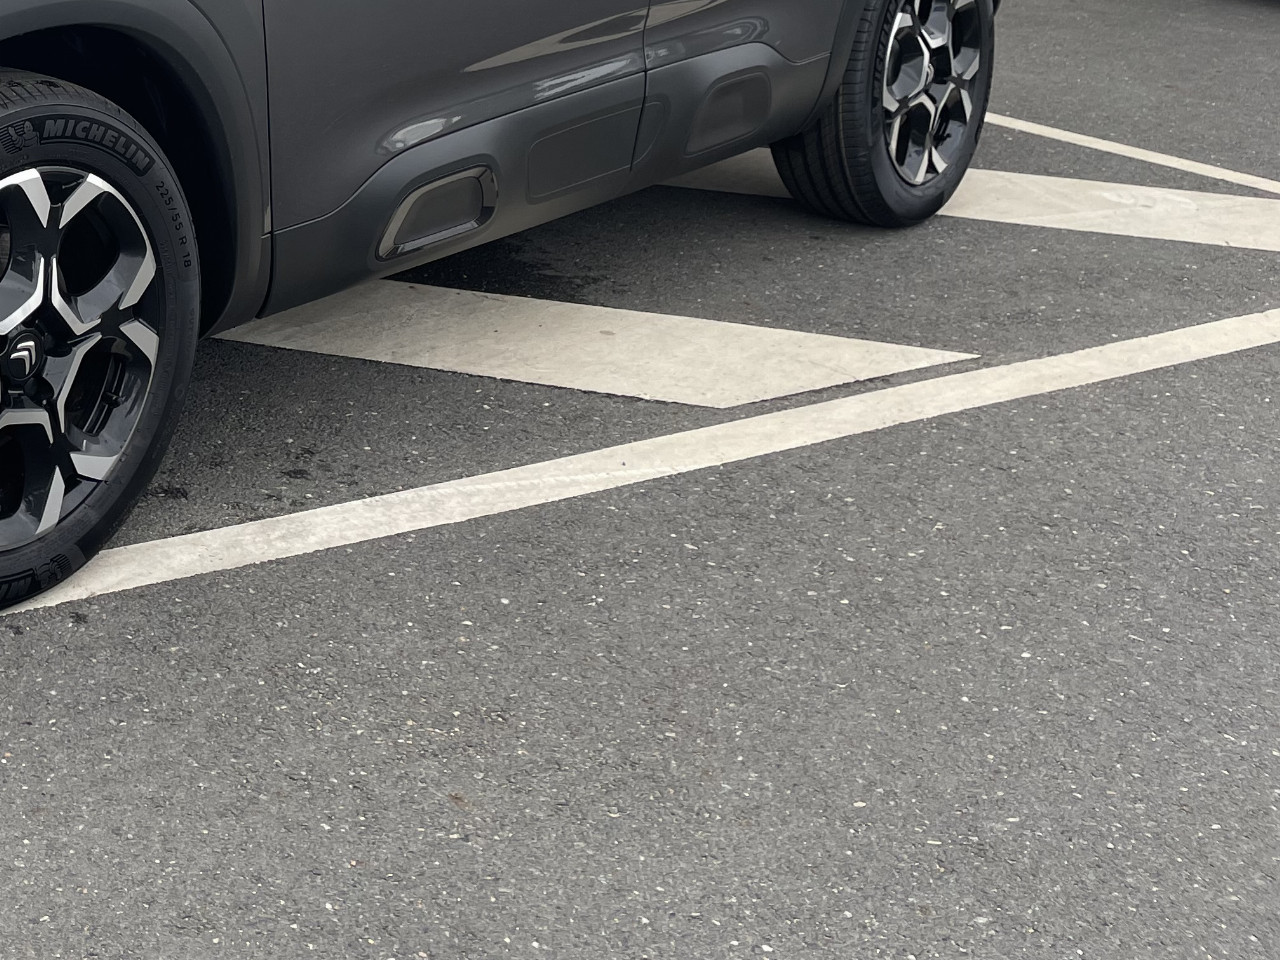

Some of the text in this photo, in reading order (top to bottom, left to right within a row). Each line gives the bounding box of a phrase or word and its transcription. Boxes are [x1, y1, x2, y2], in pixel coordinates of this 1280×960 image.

[42, 118, 151, 172] MICHELIN
[156, 181, 192, 269] 225/55 R 18
